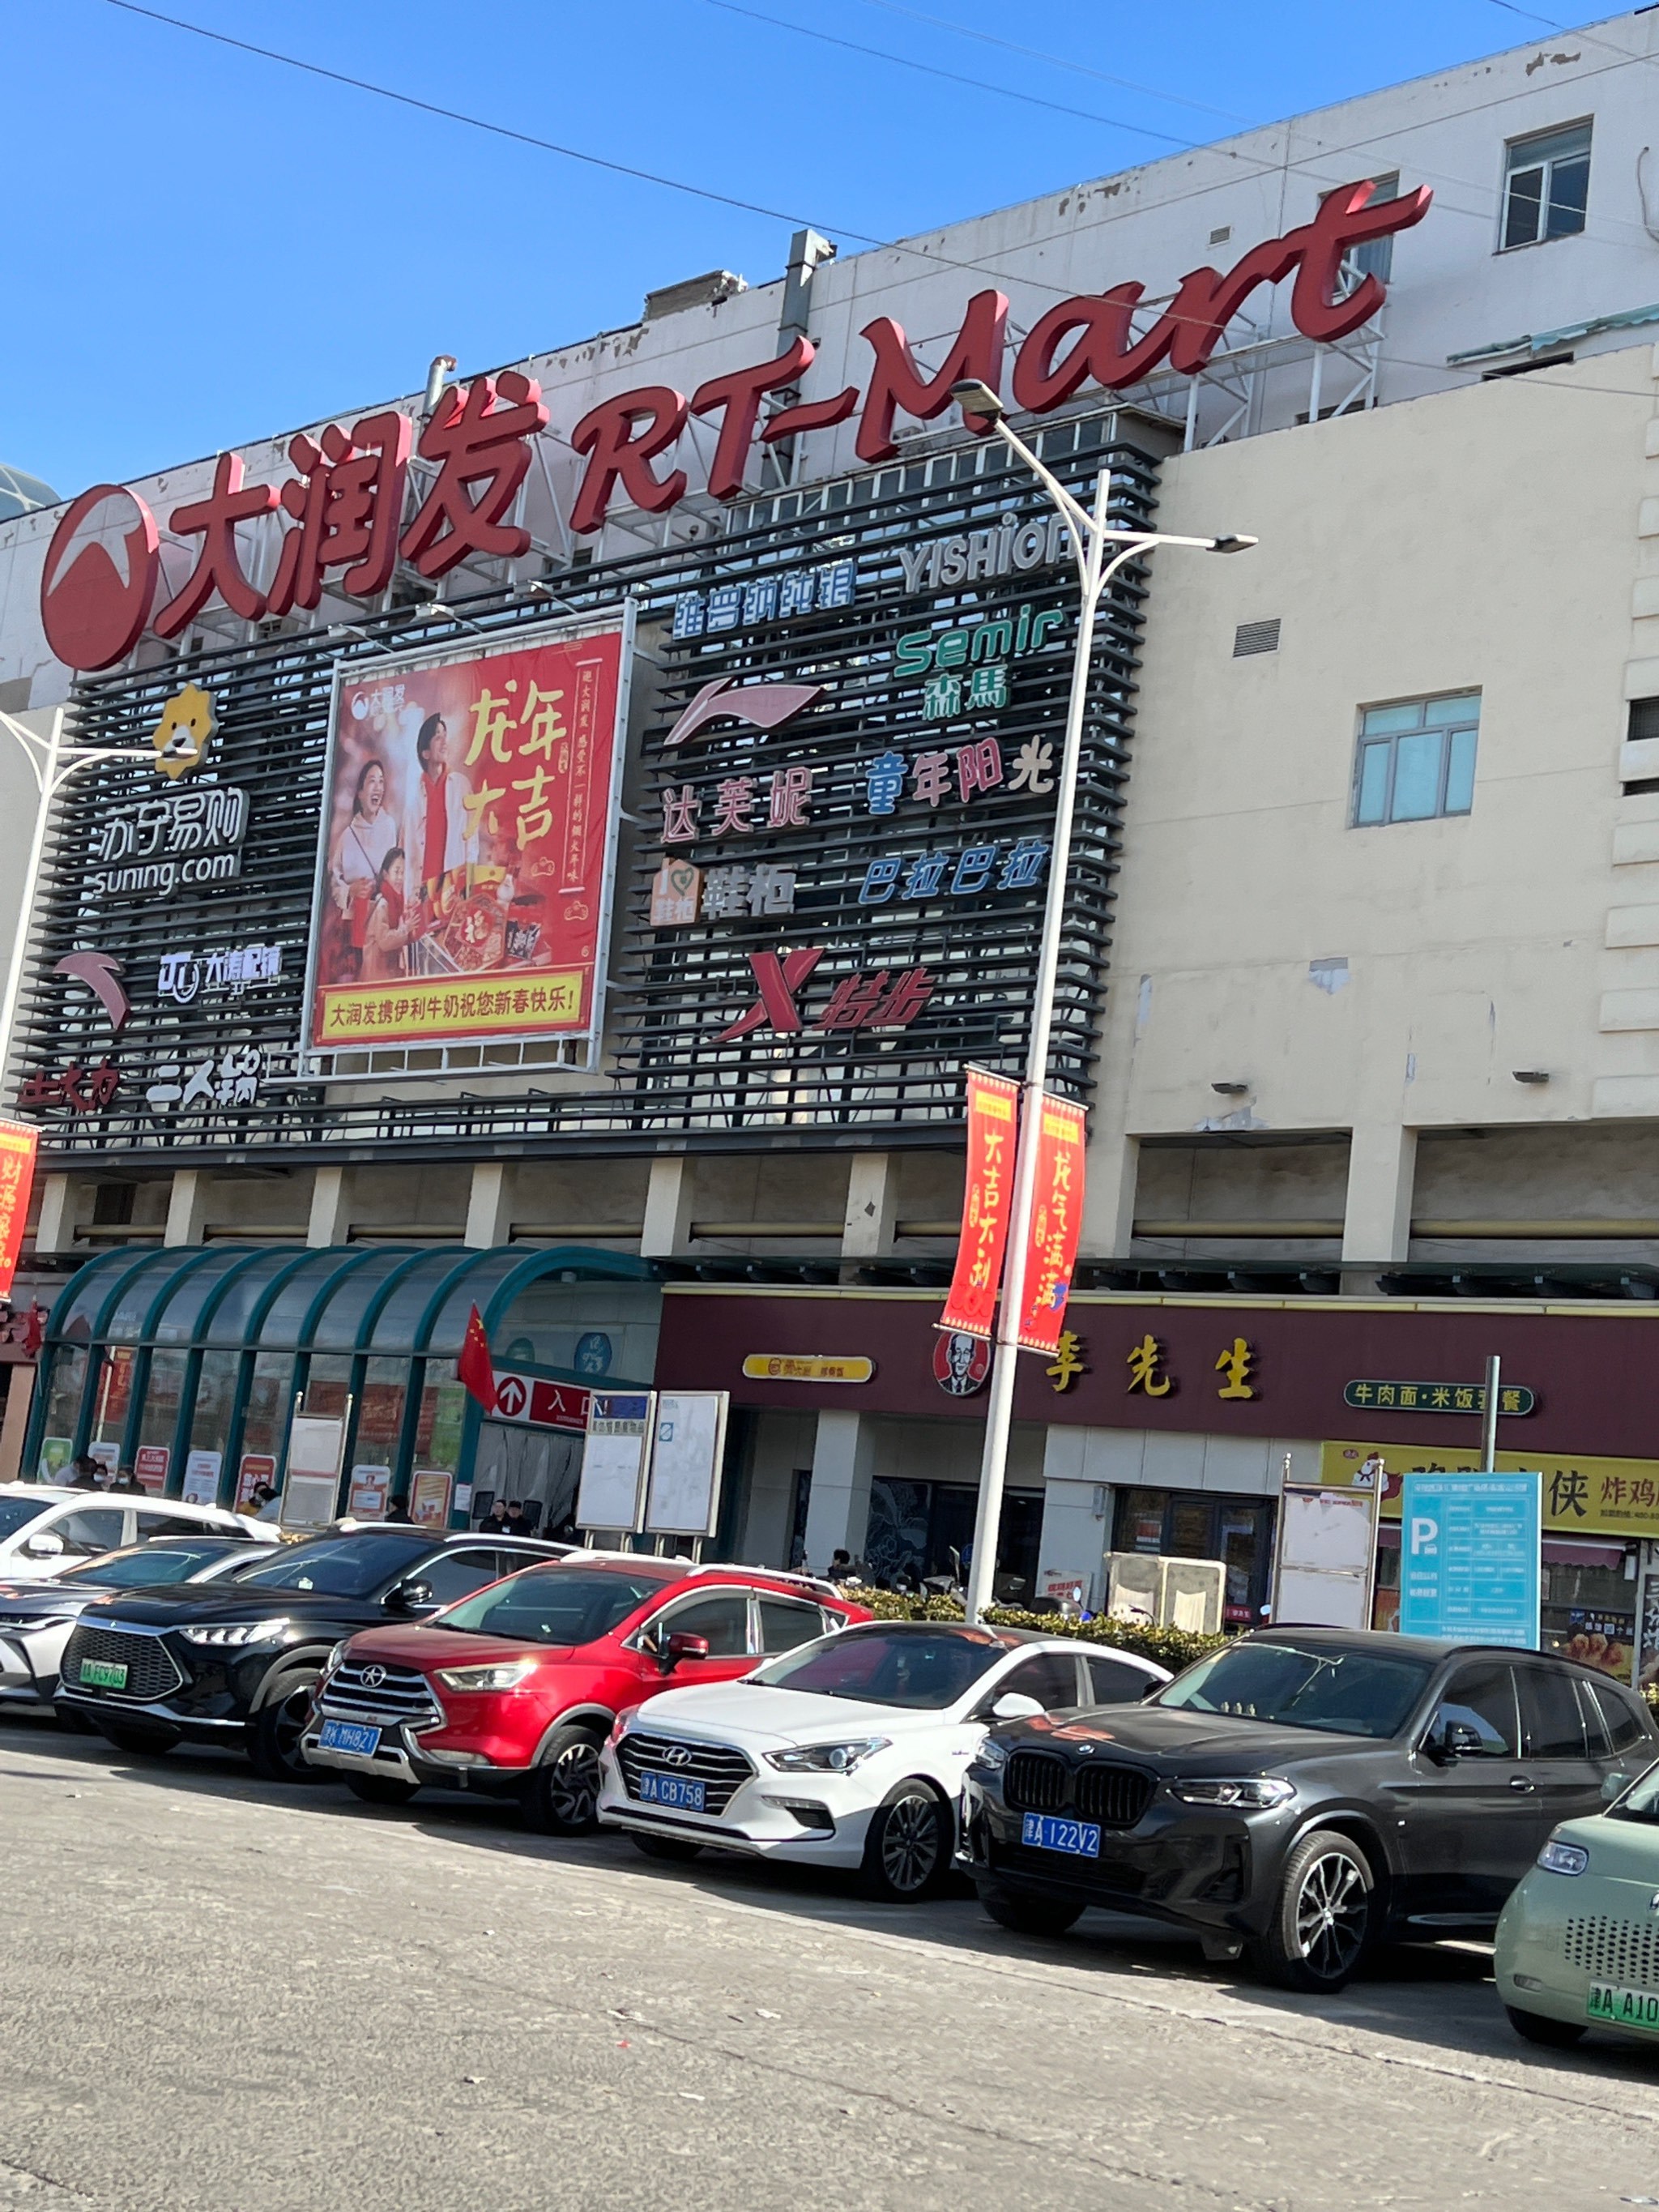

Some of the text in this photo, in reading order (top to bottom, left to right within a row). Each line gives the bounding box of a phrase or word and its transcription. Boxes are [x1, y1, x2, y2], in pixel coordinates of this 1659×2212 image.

[569, 180, 1432, 535] RT-Mart
[154, 371, 551, 638] 大润发
[894, 604, 1064, 677] Semir
[464, 677, 567, 767] 龙年
[463, 765, 557, 852] 大吉
[659, 767, 813, 844] 达芙妮
[867, 734, 1053, 816] 童年阳光
[97, 787, 249, 862] 苏宁易购
[93, 854, 241, 896] suning.com
[702, 862, 800, 921] 鞋柜
[859, 839, 1052, 905] 巴拉巴拉
[811, 967, 938, 1031] 特步
[970, 1131, 1004, 1291] 大吉大利
[1044, 1329, 1256, 1401] 李先生
[1601, 1475, 1659, 1507] 炸鸡
[1410, 1517, 1438, 1555] P
